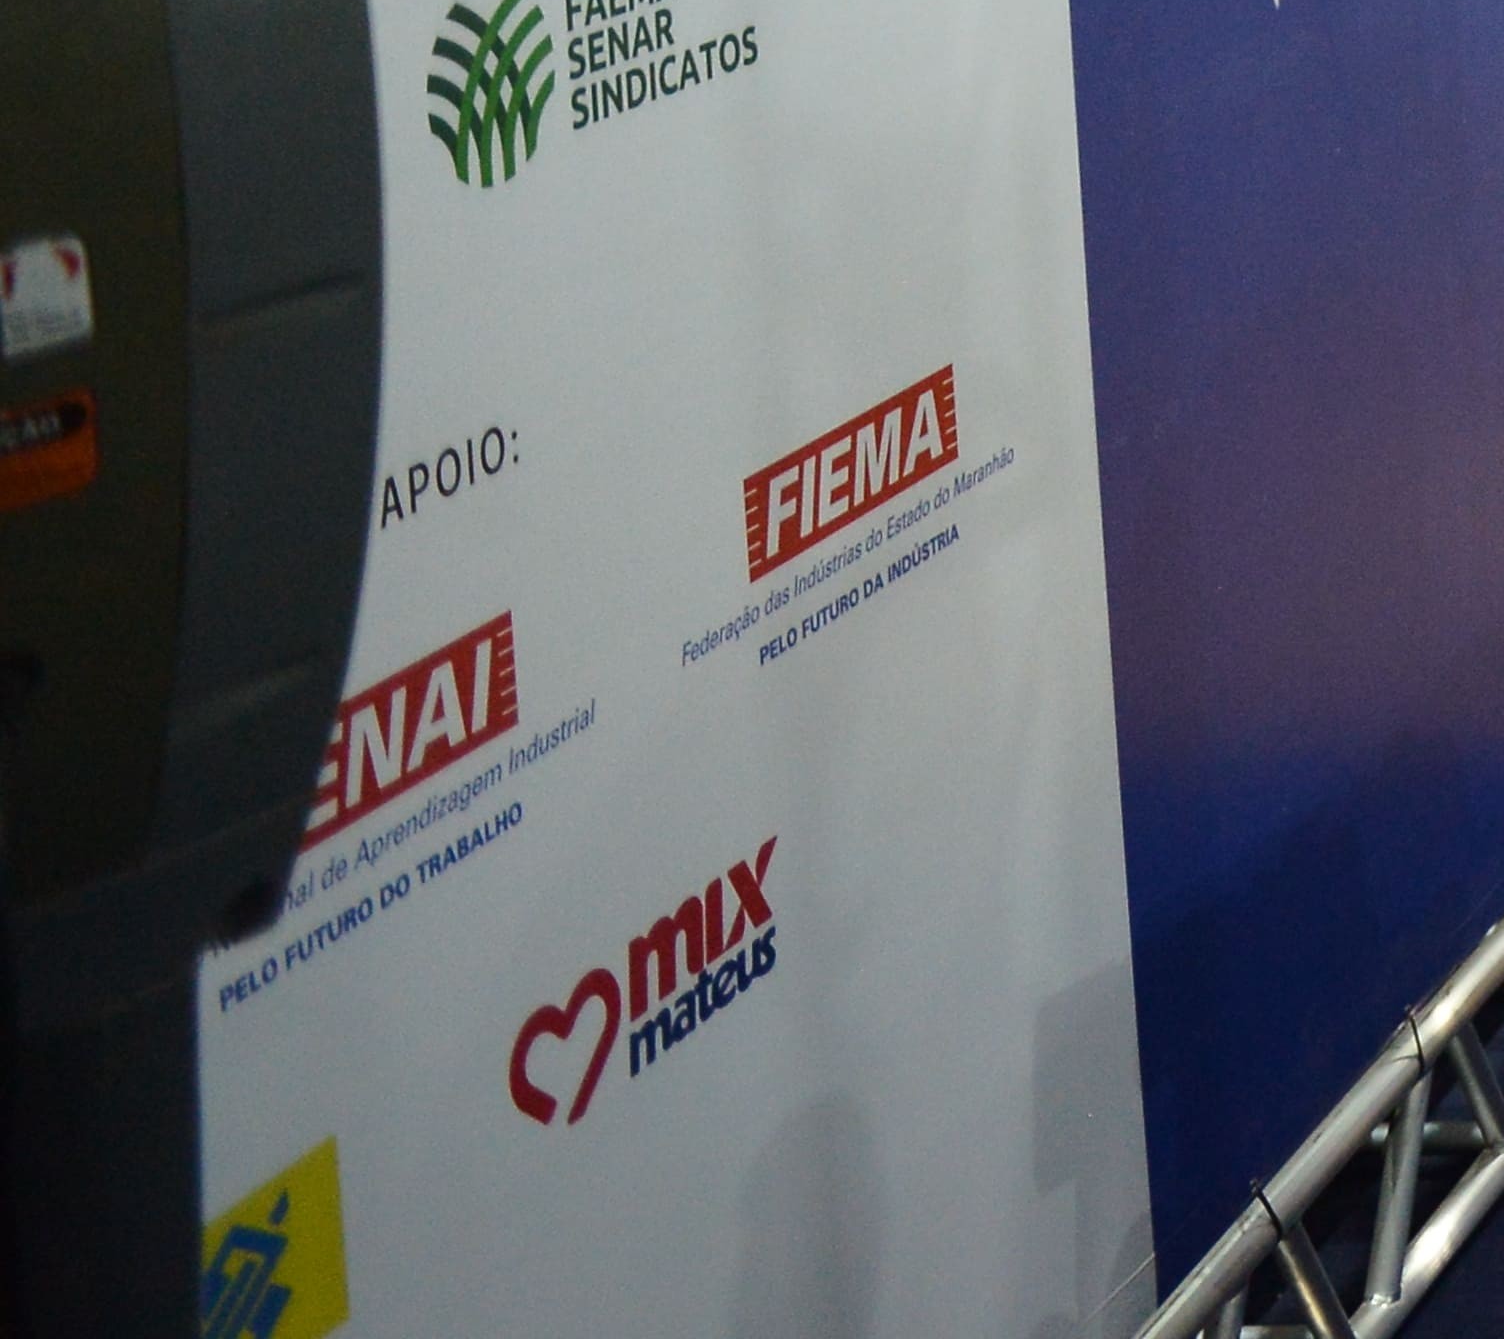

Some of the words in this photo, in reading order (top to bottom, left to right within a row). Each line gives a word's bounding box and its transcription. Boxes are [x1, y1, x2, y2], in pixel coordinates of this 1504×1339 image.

[567, 8, 675, 81] SENAR
[570, 25, 759, 131] SINDICATOS
[379, 425, 521, 531] APOIO:
[765, 388, 944, 560] FIEMA
[681, 603, 760, 667] Federação
[764, 589, 790, 616] das
[793, 544, 863, 598] Indústrias
[865, 528, 883, 552] do
[886, 499, 931, 541] Estado
[933, 485, 950, 510] do
[953, 445, 1015, 498] Maranhão
[758, 626, 798, 666] PELO
[801, 587, 859, 639] FUTURO
[863, 574, 884, 600] DA
[887, 523, 960, 584] INDÚSTRIA
[321, 856, 349, 892] de
[354, 760, 503, 872] Aprendizagem
[508, 698, 596, 776] Industrial
[219, 956, 279, 1013] PELO
[284, 896, 374, 971] FUTURO
[380, 871, 411, 911] DO
[416, 801, 524, 884] TRABALHO
[629, 925, 777, 1078] mateus
